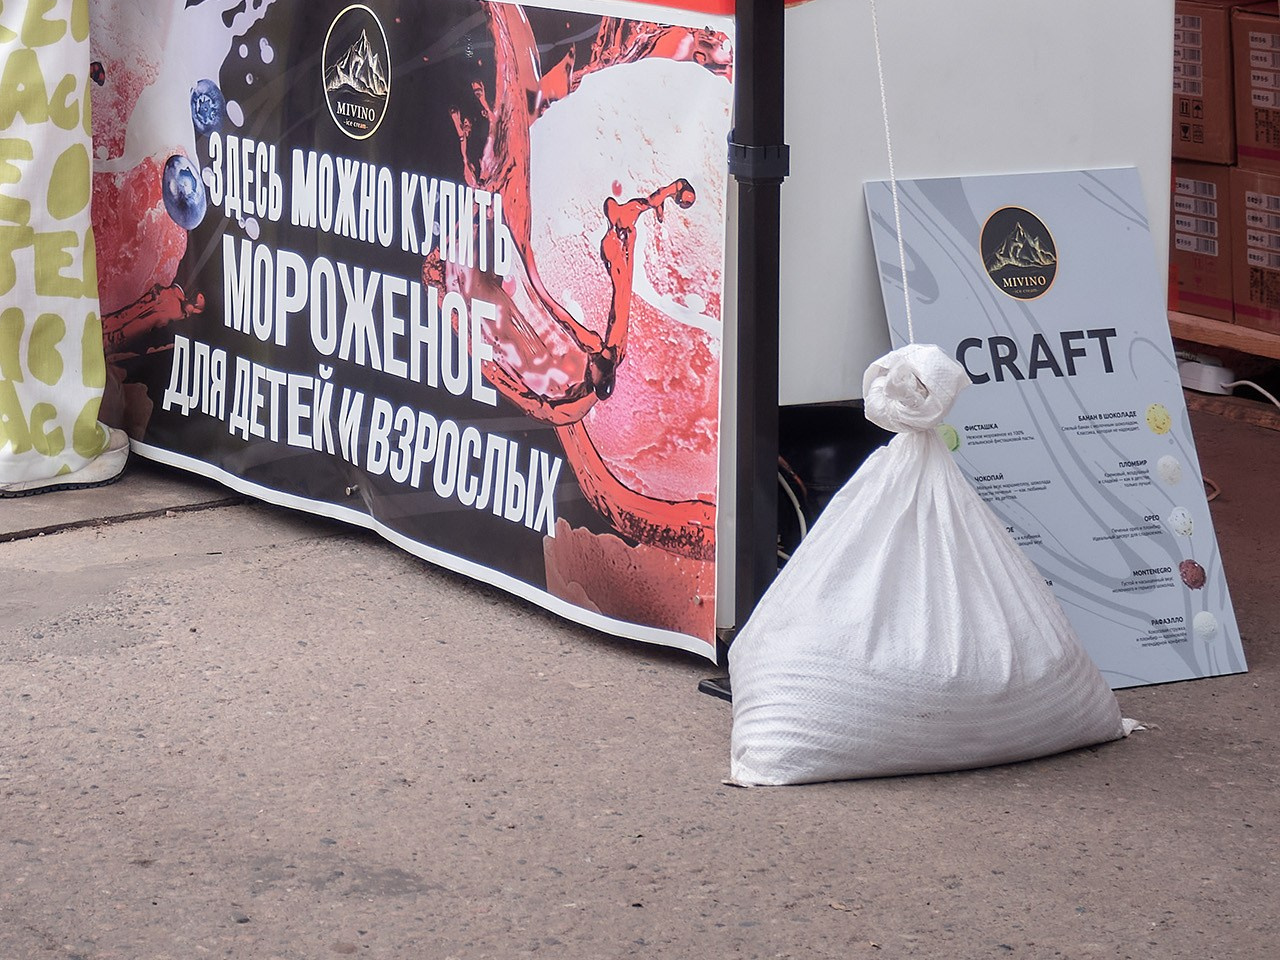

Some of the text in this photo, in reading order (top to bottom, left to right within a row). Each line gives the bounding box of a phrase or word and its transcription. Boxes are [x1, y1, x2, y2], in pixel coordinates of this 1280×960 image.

[337, 101, 375, 122] MIVINO
[208, 131, 512, 278] ЗДЕСЬ МОЖНО КУПИТЬ
[1002, 275, 1047, 288] MIVINO
[222, 233, 498, 408] МОРОЖЕНОЕ
[956, 328, 1117, 384] CRAFT
[1078, 414, 1098, 422] БАНАН
[1103, 411, 1137, 419] ШОКОЛАДЕ
[964, 423, 999, 431] ФИСТАШКА
[162, 334, 563, 539] ДЛЯ ДЕТЕЙ И ВЗРОСЛЫХ
[1119, 460, 1147, 468] ПЛОМБИР
[974, 473, 1004, 482] ЧОКОПАЙ
[1144, 514, 1160, 522] ОРЕО
[1133, 566, 1172, 576] MONTENEGRO
[1151, 616, 1183, 625] РАФАЭЛЛО
